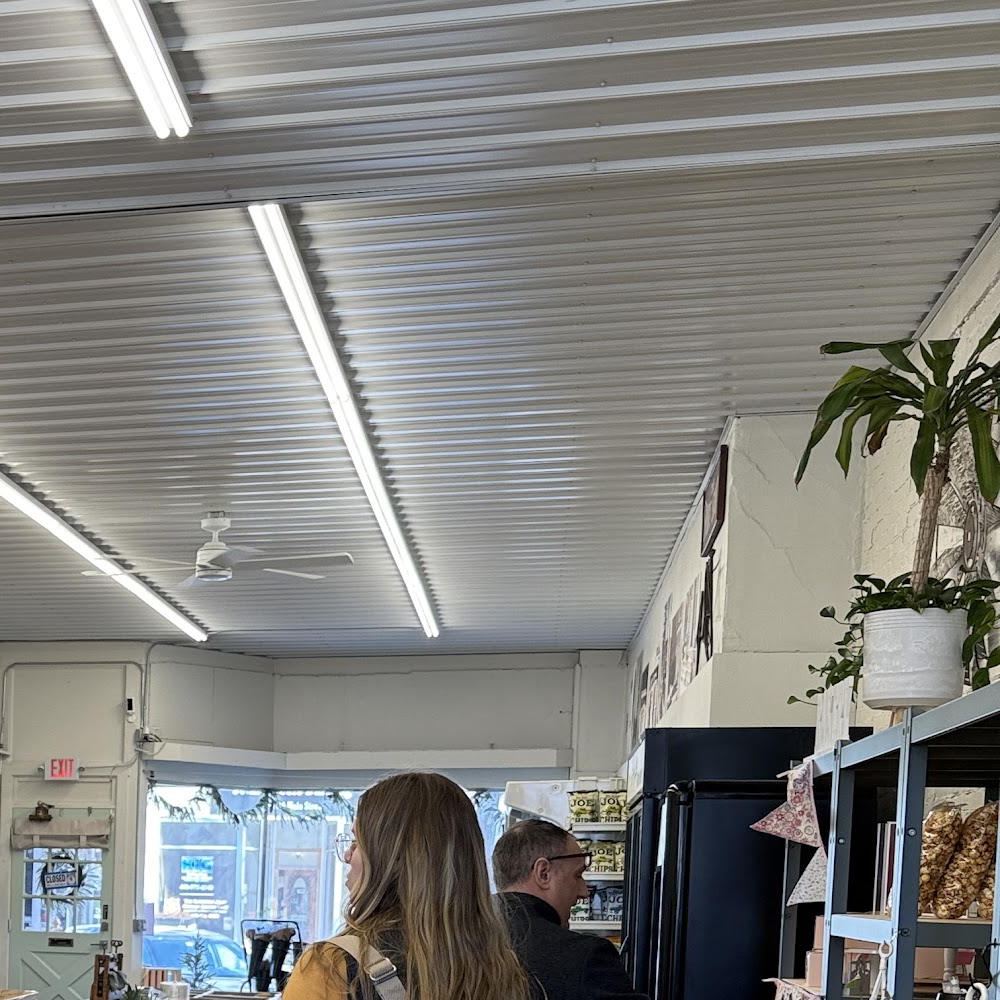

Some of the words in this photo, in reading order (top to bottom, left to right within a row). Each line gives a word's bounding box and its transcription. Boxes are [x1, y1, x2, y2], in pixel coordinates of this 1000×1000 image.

[50, 759, 74, 778] EXIT
[571, 799, 595, 807] JOE
[46, 874, 65, 883] CLOSED
